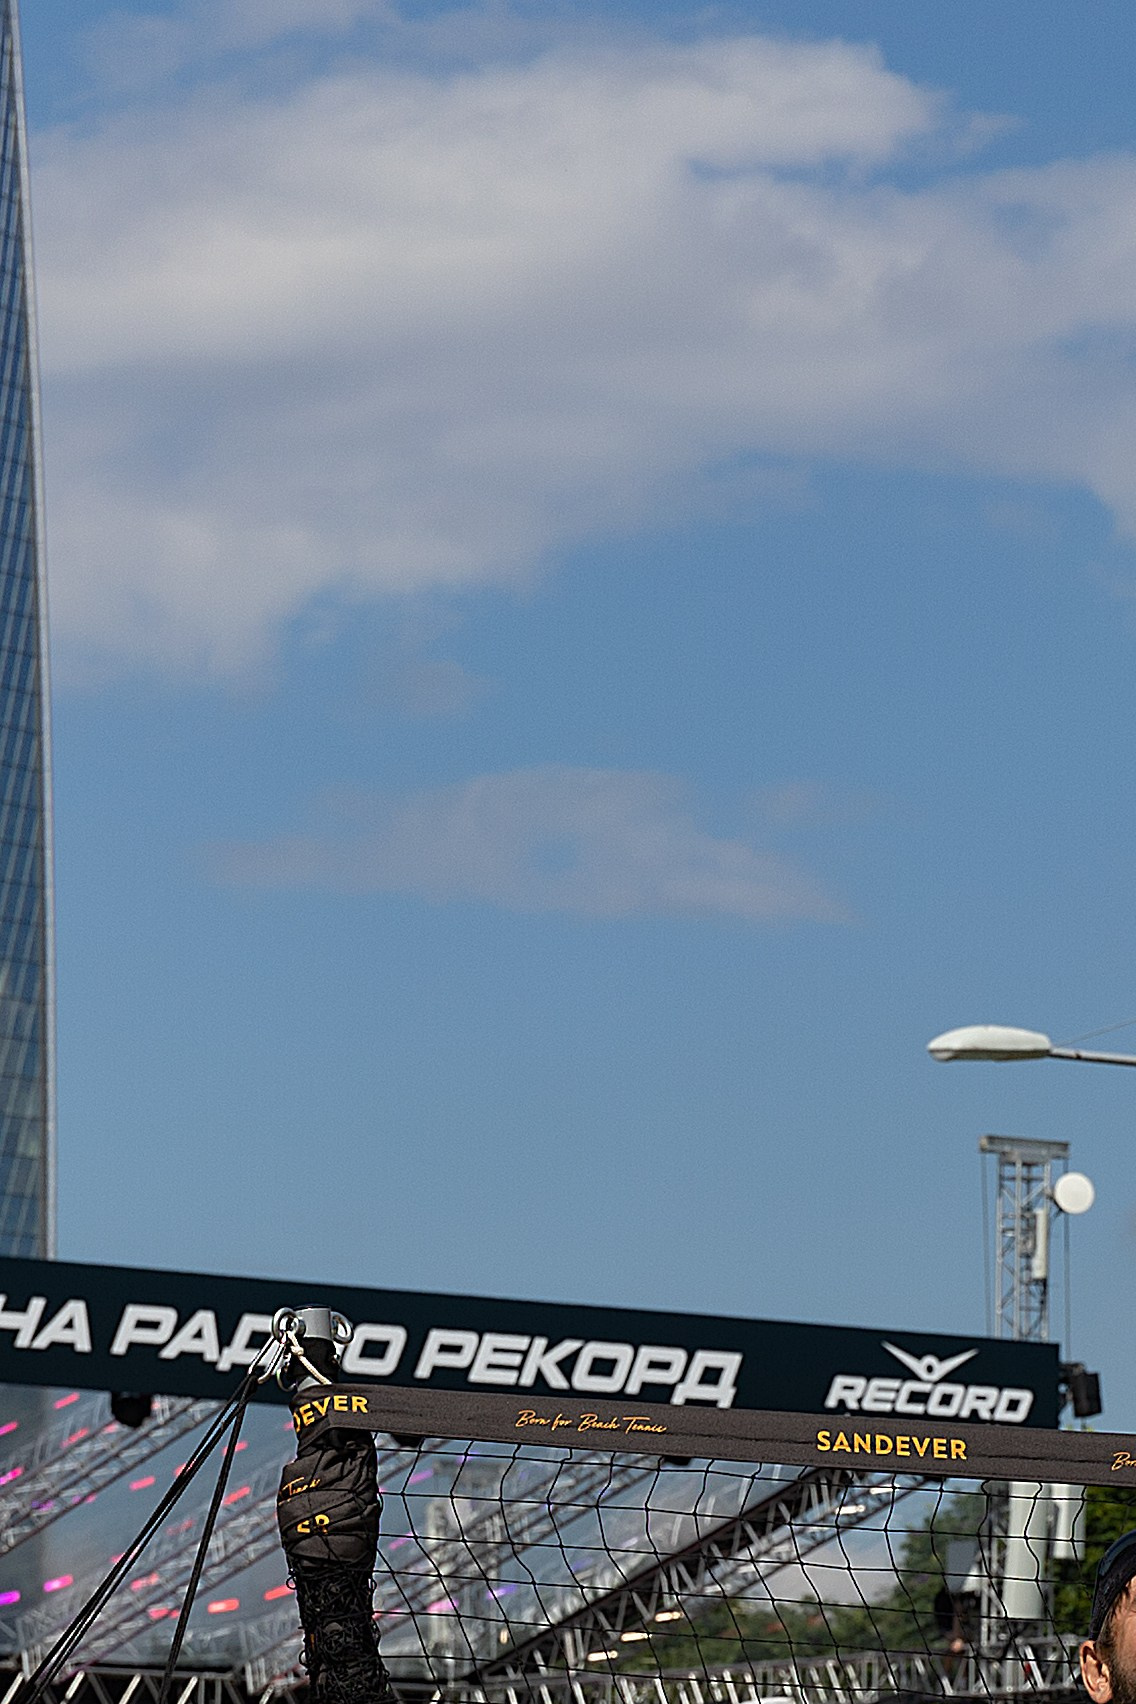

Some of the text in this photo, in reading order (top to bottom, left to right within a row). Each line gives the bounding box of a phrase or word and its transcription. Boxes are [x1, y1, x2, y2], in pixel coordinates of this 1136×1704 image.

[110, 1303, 408, 1377] РАДО
[413, 1327, 743, 1409] РЕКОРД
[823, 1374, 1035, 1424] RECORD
[515, 1409, 668, 1435] Born for Beach Tennis
[816, 1430, 968, 1460] SANDEVER
